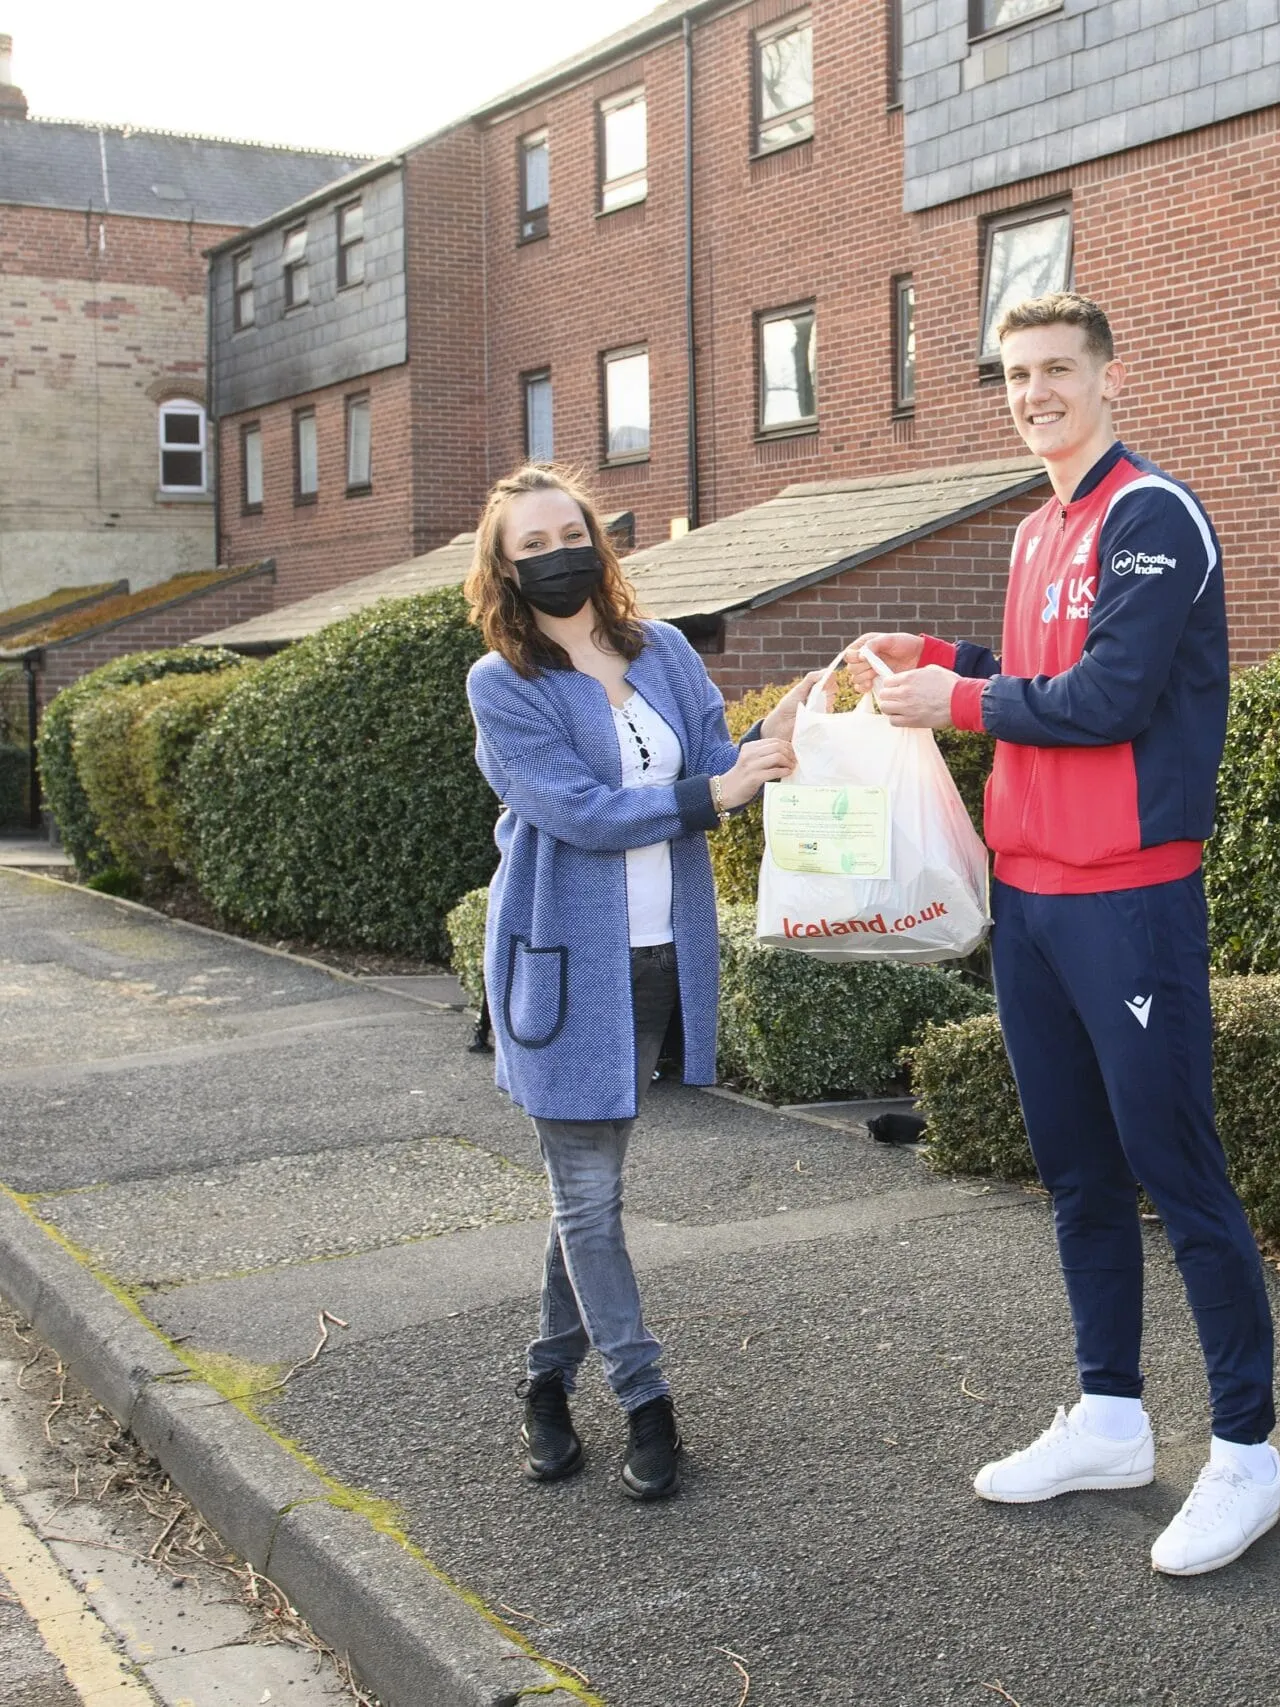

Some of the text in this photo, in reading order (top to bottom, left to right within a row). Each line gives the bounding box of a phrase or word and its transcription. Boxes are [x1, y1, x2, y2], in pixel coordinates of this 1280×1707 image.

[1134, 563, 1165, 575] Index
[1068, 575, 1097, 603] UK
[782, 901, 949, 939] Iceland.co.uk
